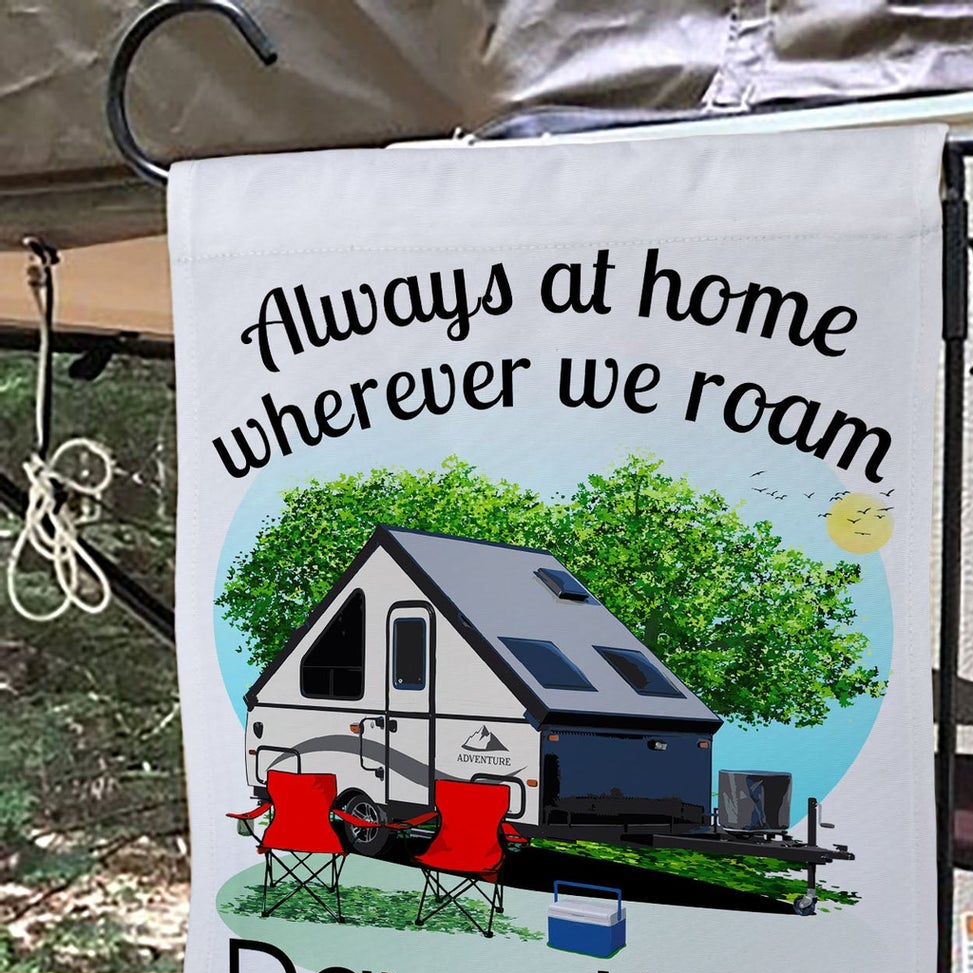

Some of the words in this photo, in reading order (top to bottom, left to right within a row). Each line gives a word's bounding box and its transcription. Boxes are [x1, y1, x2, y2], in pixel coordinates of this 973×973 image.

[241, 262, 513, 372] Always
[541, 249, 615, 314] at
[639, 248, 858, 356] home
[212, 358, 531, 479] wherever
[559, 357, 661, 413] we
[685, 372, 893, 483] roam
[456, 753, 512, 766] ADVENTURE
